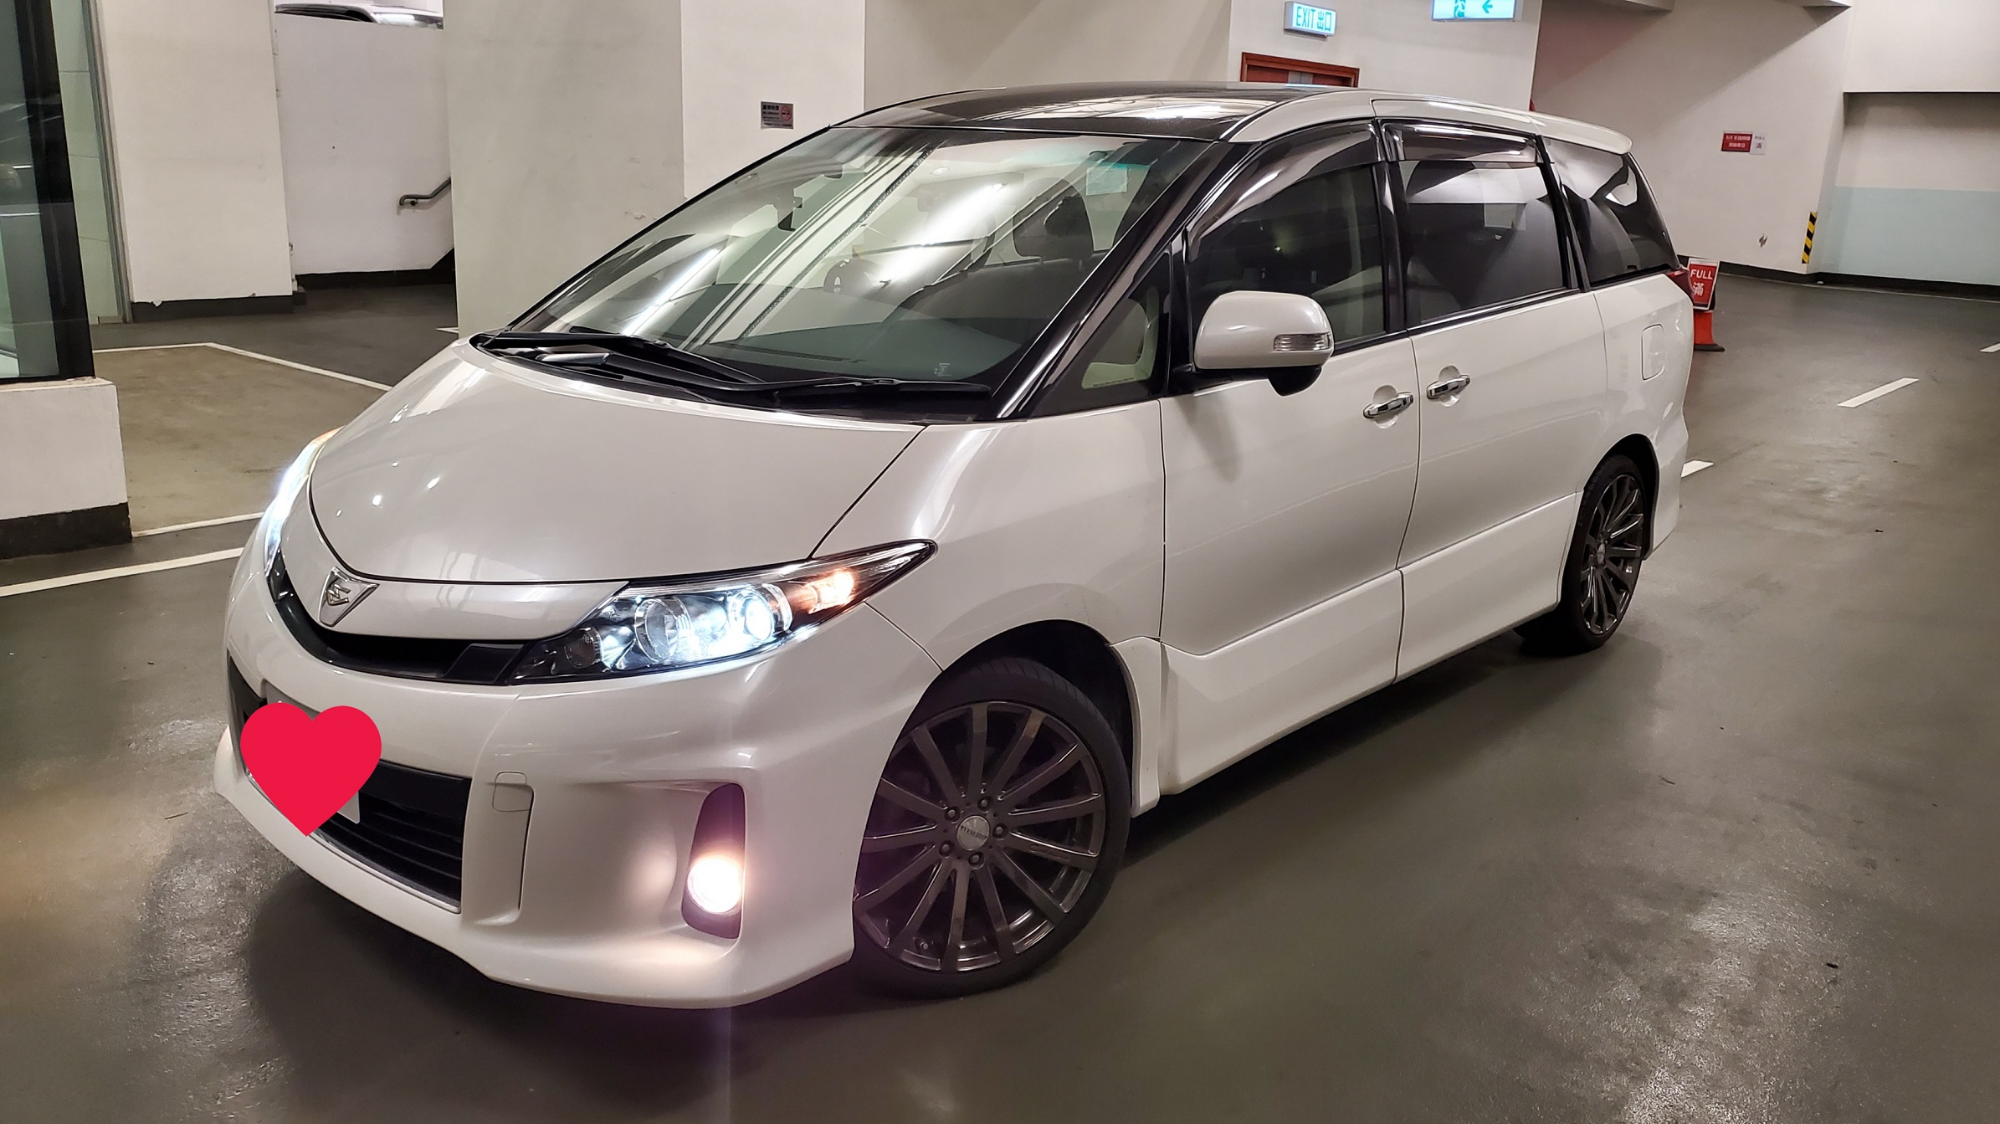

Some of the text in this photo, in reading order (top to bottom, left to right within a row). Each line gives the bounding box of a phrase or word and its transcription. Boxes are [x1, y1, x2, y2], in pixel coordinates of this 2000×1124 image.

[1296, 6, 1333, 32] EXIT 出口
[1690, 269, 1713, 280] FULL
